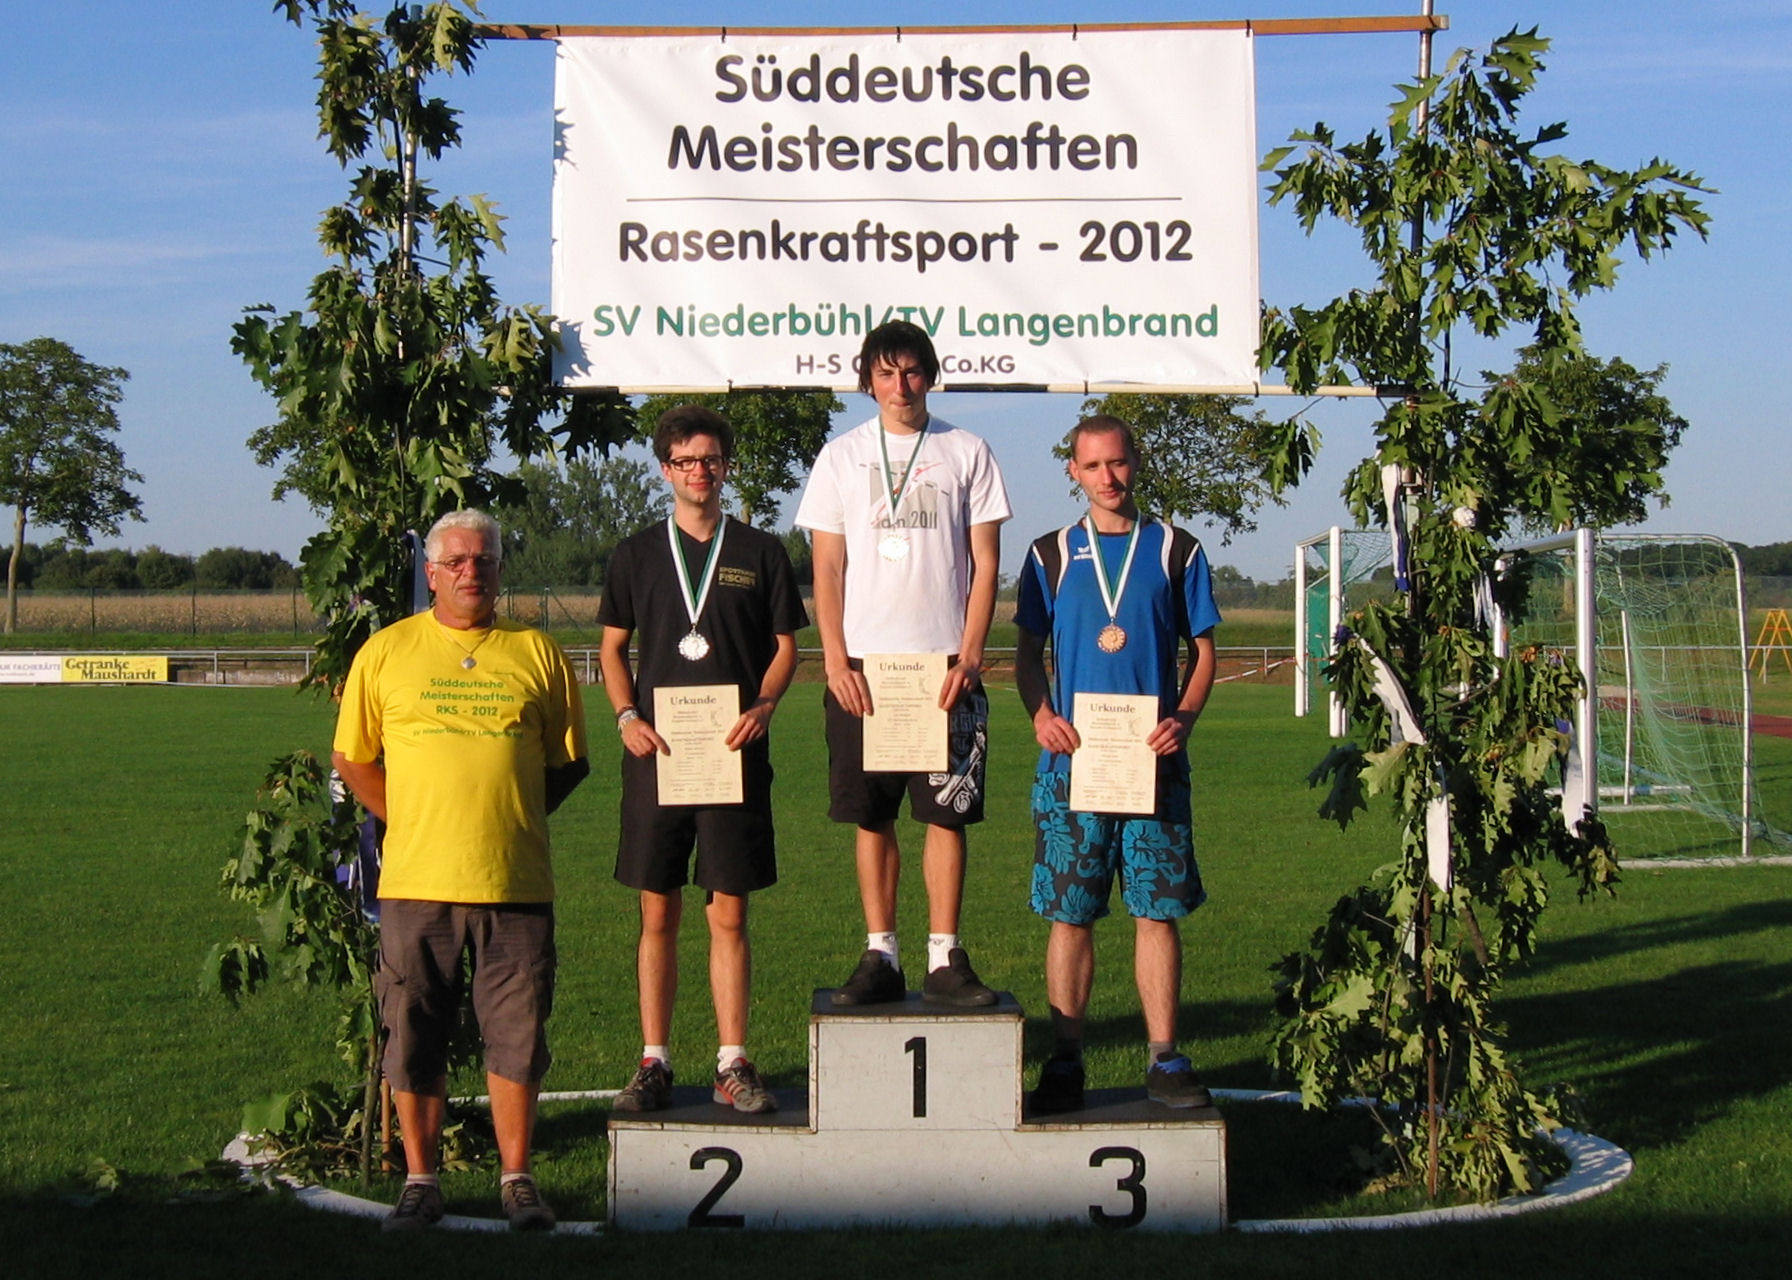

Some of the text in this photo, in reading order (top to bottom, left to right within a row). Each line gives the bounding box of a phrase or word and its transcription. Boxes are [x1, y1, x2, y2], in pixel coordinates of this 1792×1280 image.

[715, 51, 1091, 104] Süddeutsche
[667, 121, 1139, 174] Meisterschaften
[619, 219, 1194, 274] Rasenkraftsport - 2012
[593, 306, 642, 338] SV
[958, 304, 1219, 347] Langenbrand
[796, 354, 842, 375] H-S
[81, 669, 156, 681] Maushardt
[878, 662, 925, 672] Urkunde
[430, 678, 504, 688] Süddeutsche
[420, 691, 515, 702] Meisterschaften
[670, 695, 717, 706] Urkunde
[436, 705, 459, 715] RKS
[472, 706, 498, 716] 2012
[1090, 703, 1136, 713] Urkunde
[904, 1036, 927, 1118] 1
[688, 1146, 745, 1228] 2
[1088, 1146, 1148, 1228] 3
